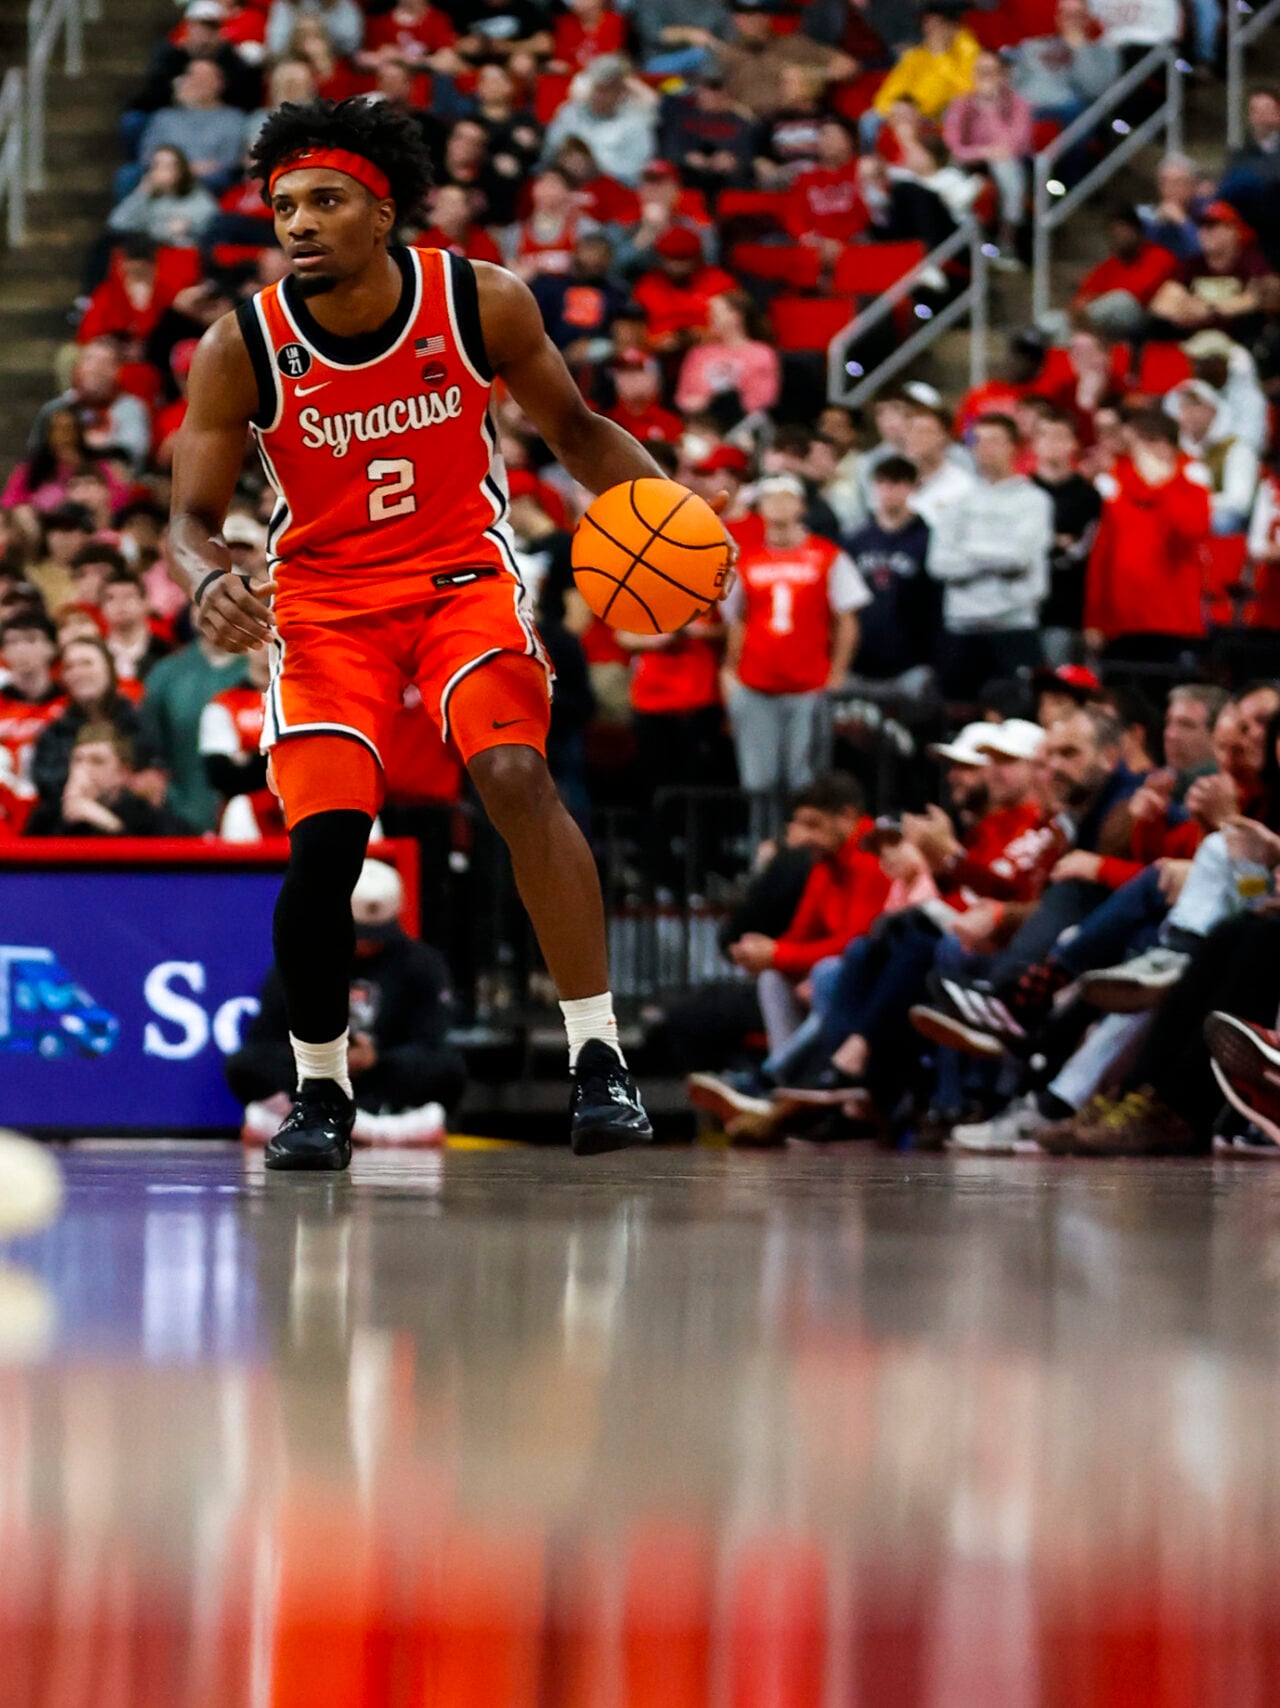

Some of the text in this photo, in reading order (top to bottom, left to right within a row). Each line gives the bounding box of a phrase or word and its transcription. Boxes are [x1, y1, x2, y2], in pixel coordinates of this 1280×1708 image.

[285, 346, 299, 359] LM
[288, 358, 303, 374] 21
[299, 386, 463, 458] Syracuse
[367, 458, 417, 522] 2
